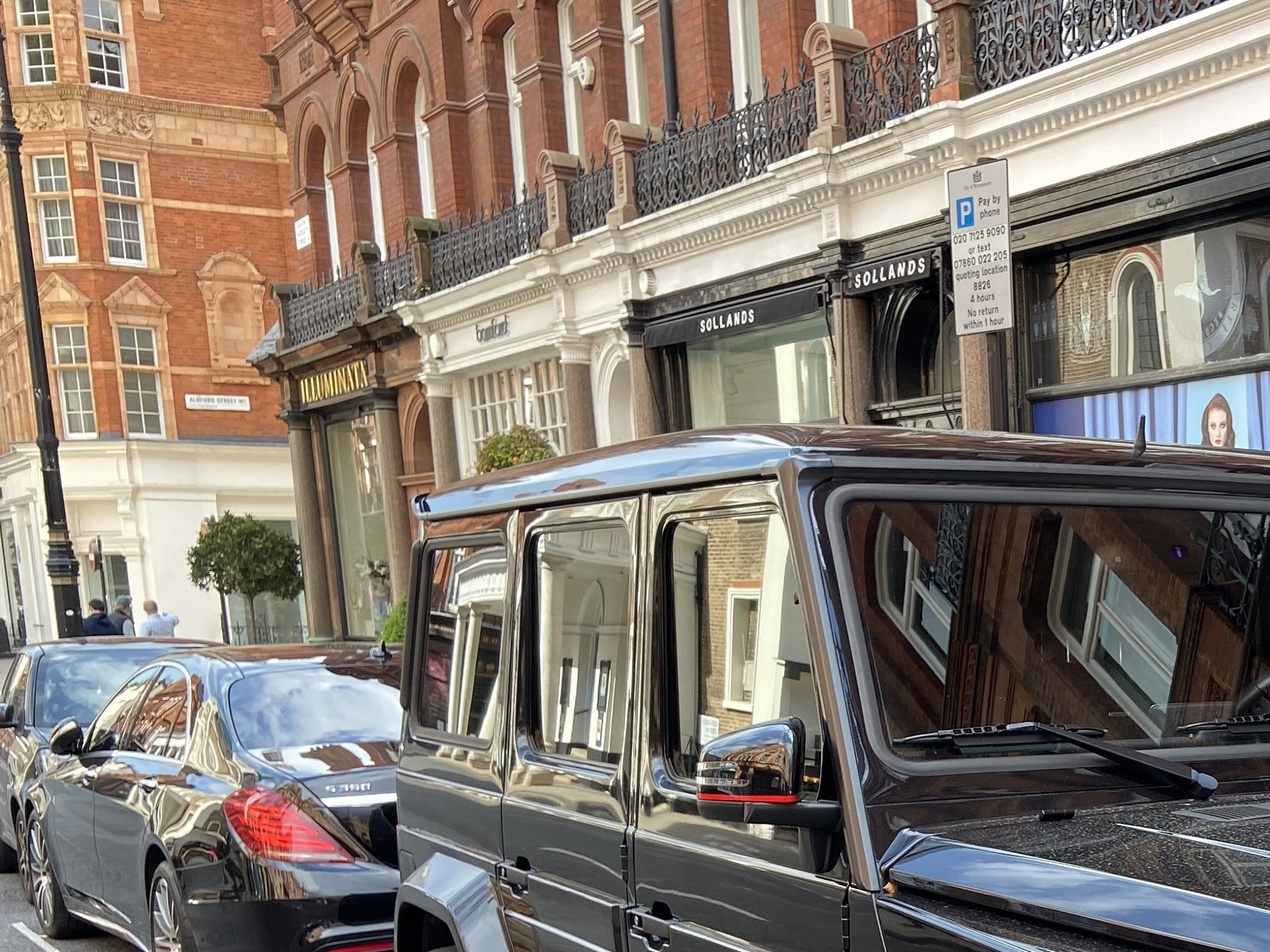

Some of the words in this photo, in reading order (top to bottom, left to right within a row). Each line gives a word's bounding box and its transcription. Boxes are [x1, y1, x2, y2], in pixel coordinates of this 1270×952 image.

[978, 197, 990, 206] Pay
[992, 195, 1001, 204] by
[960, 201, 972, 226] P
[980, 208, 1000, 220] phone
[954, 234, 967, 244] 020
[969, 230, 984, 241] 7125
[986, 225, 1005, 238] 9090
[968, 247, 975, 255] or
[978, 242, 991, 253] text
[954, 256, 976, 269] 07860
[978, 254, 991, 264] 022
[993, 250, 1007, 261] 205
[854, 257, 925, 289] SOLLANDS
[956, 269, 979, 281] quoting
[982, 264, 1008, 276] location
[974, 280, 991, 291] 8826
[970, 294, 975, 303] 4
[977, 293, 995, 302] hours
[968, 309, 977, 317] No
[978, 306, 999, 316] return
[700, 309, 754, 333] SOLLANDS
[963, 320, 983, 330] within
[990, 318, 1004, 326] hour
